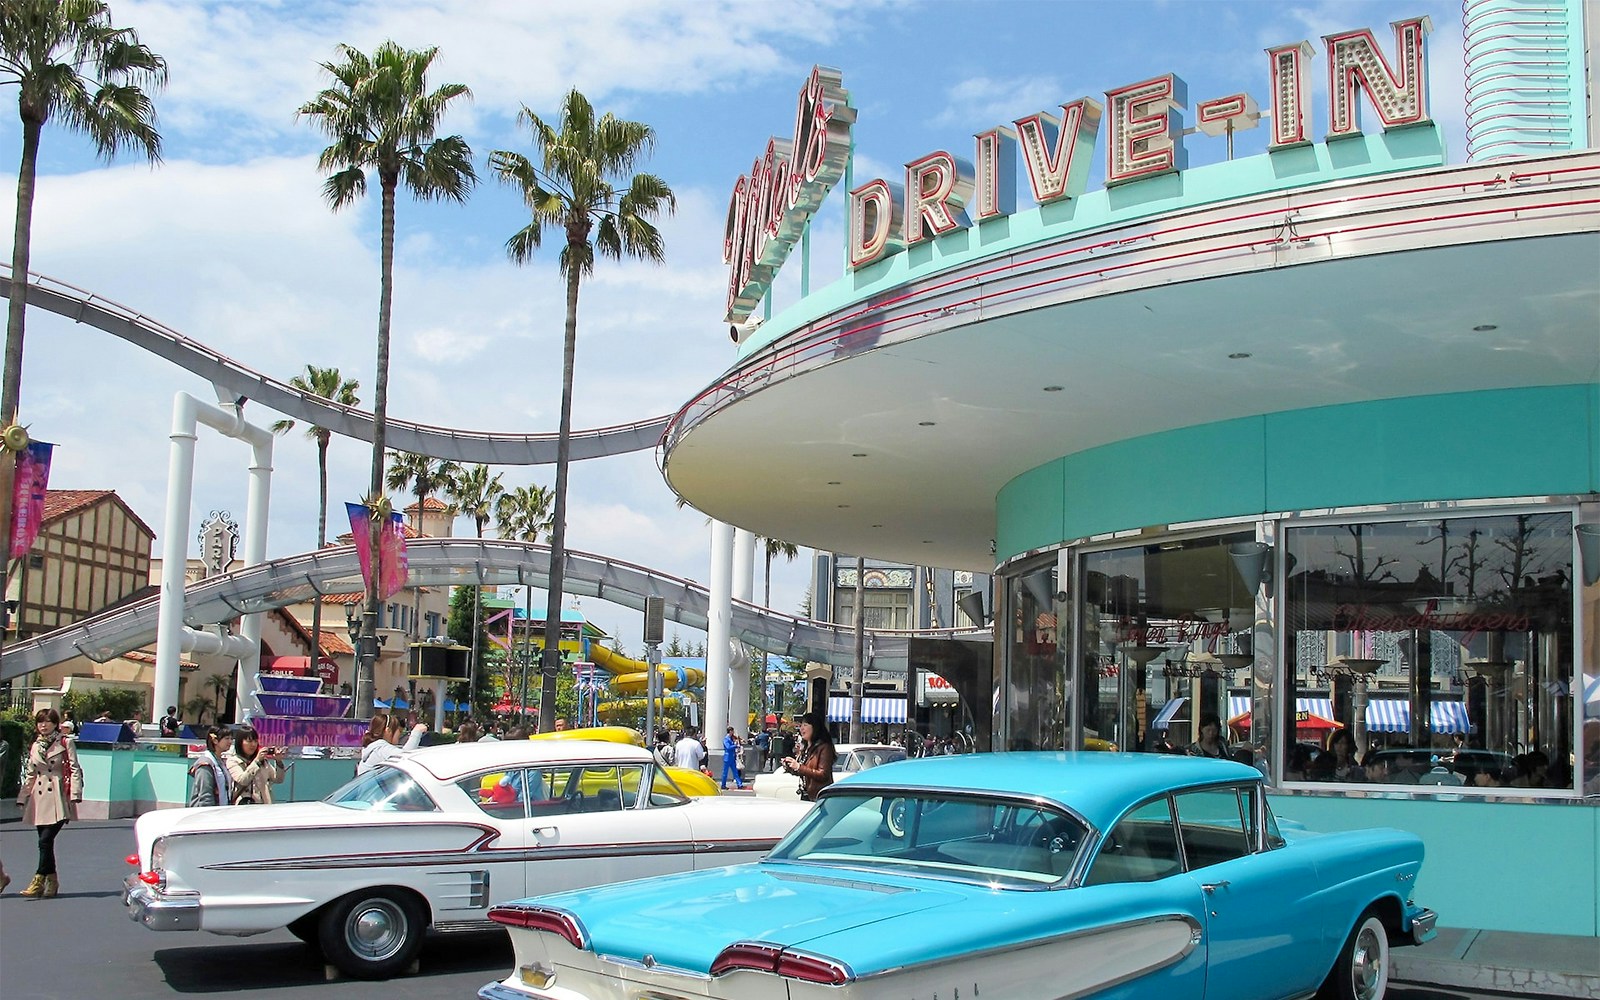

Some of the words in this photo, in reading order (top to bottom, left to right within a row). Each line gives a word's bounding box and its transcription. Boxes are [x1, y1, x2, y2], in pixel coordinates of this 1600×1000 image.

[849, 15, 1431, 271] DRIVE-IN
[212, 527, 223, 571] PARK
[928, 676, 952, 689] ROC
